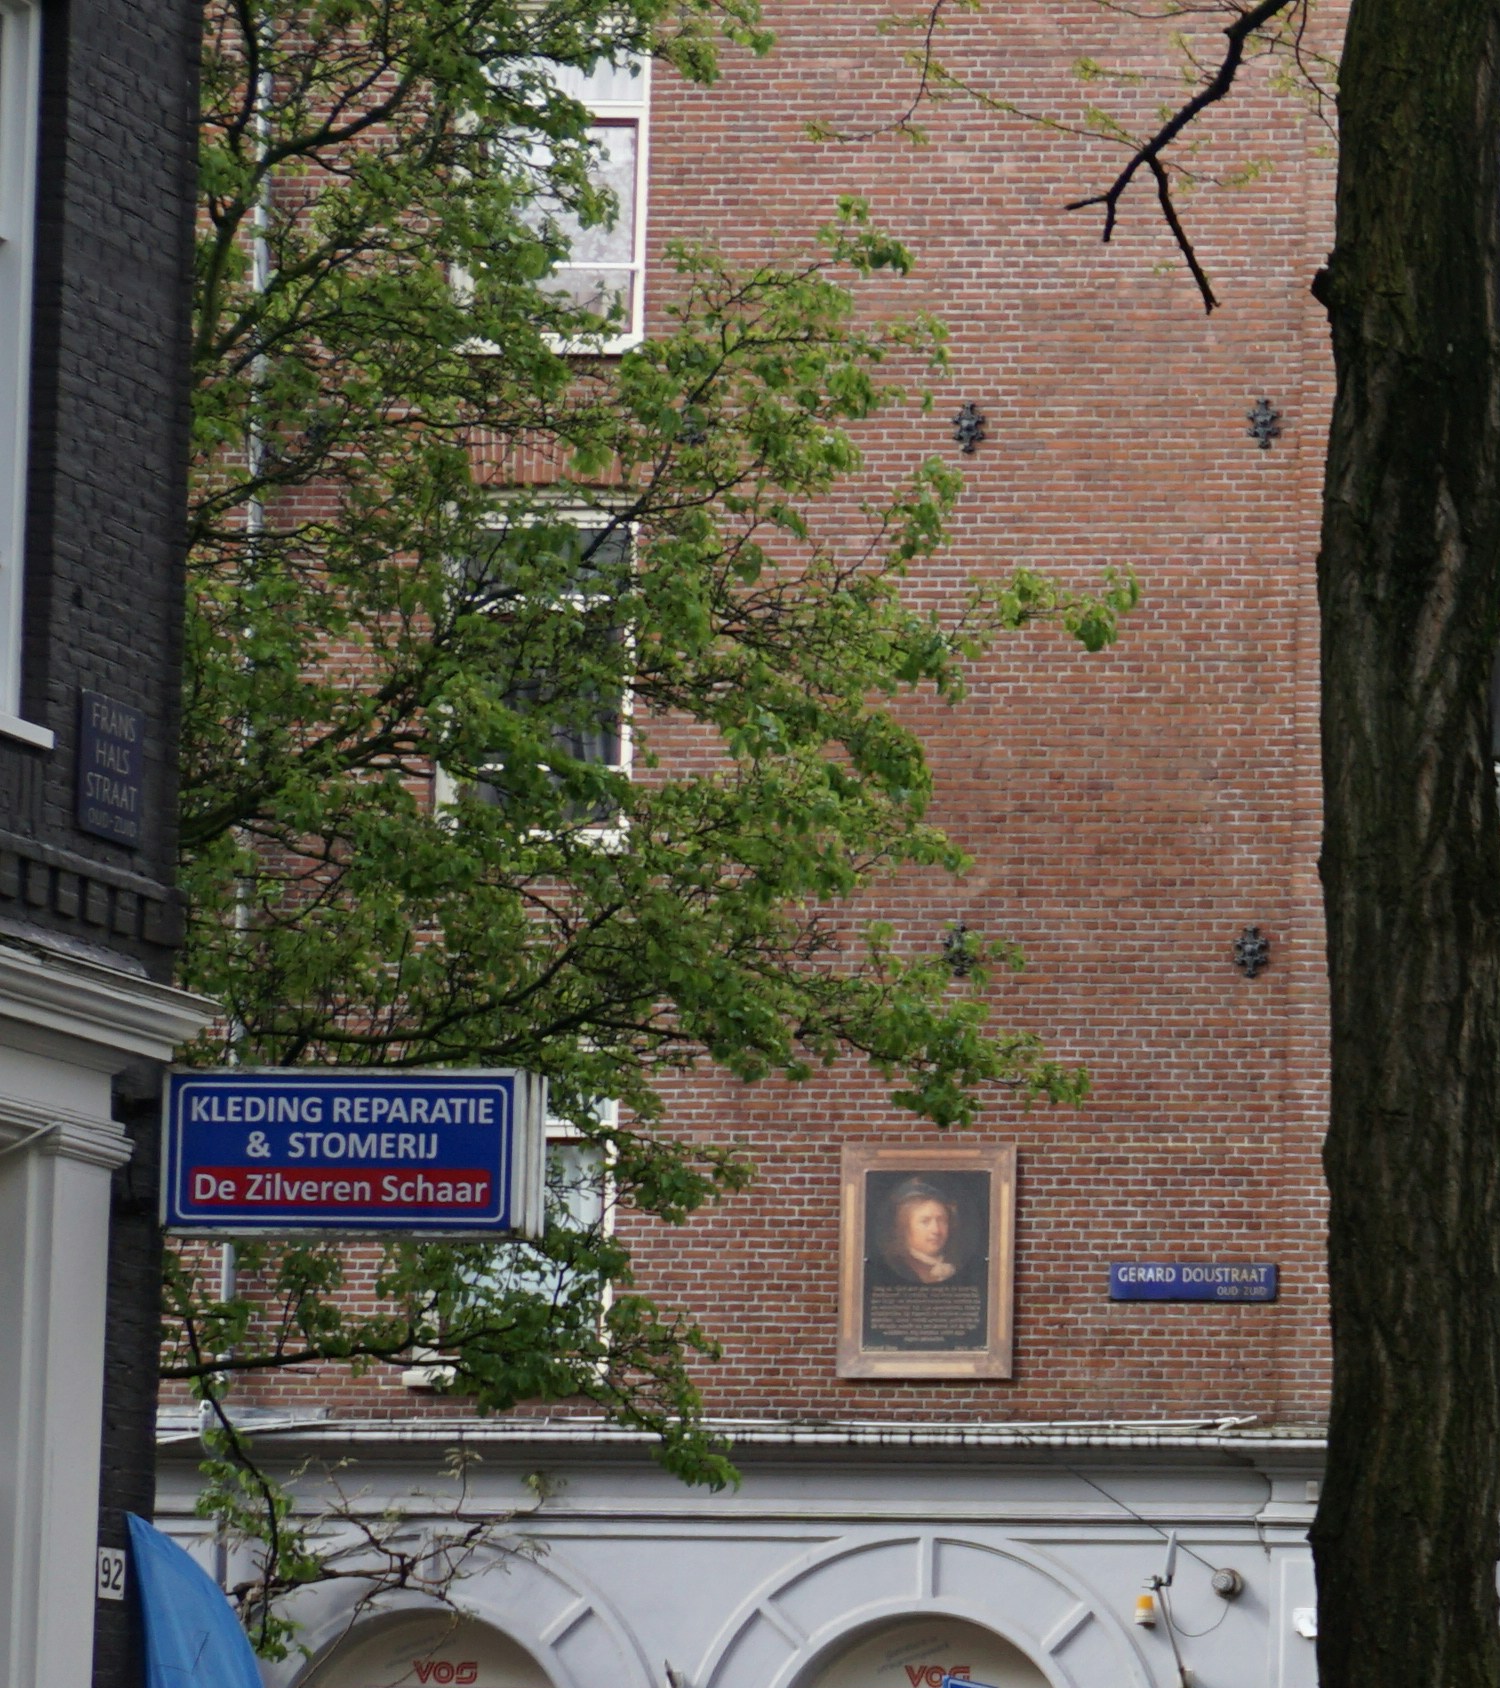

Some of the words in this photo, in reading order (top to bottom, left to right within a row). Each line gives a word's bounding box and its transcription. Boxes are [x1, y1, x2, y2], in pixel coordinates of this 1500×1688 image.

[92, 702, 136, 742] FRANS
[96, 740, 130, 775] HALS
[86, 772, 137, 812] STRAAT
[191, 1096, 323, 1123] KLEDING
[333, 1097, 494, 1124] REPARATIE
[246, 1130, 271, 1158] &
[288, 1132, 438, 1159] STOMERIJ
[194, 1173, 236, 1200] De
[245, 1174, 371, 1202] Zilveren
[381, 1174, 487, 1203] Schaar
[1118, 1267, 1176, 1283] GERARD
[1182, 1267, 1267, 1283] DOUSTRAAT
[1217, 1286, 1238, 1296] OUD
[101, 1557, 123, 1591] 92
[413, 1660, 478, 1684] VOS
